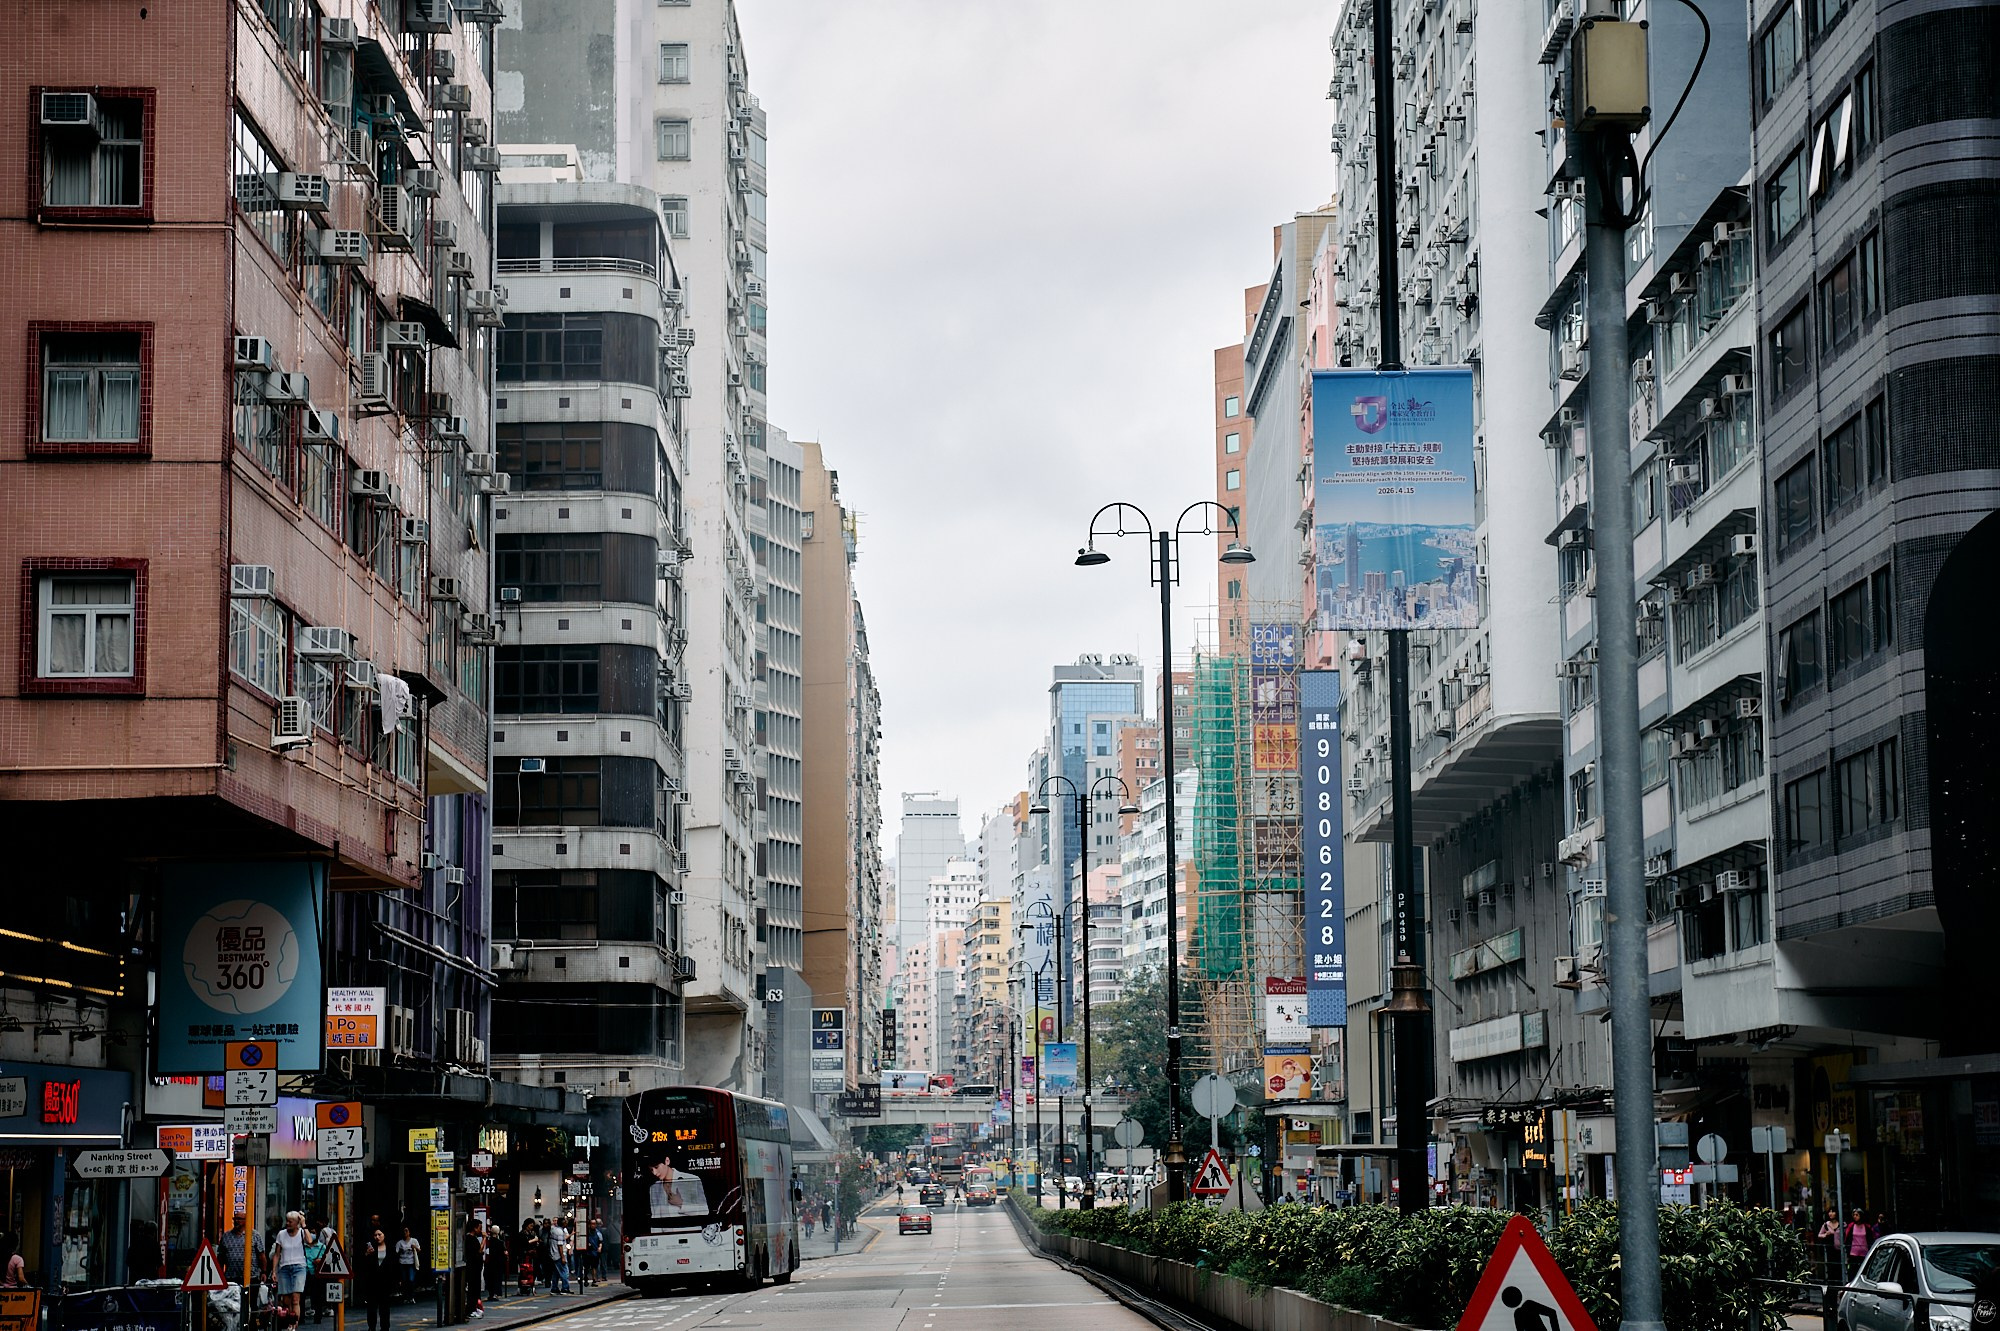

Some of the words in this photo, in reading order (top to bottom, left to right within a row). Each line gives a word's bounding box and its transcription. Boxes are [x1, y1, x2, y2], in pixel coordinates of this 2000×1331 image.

[1352, 455, 1434, 466] 堅持統籌發展和安全
[1378, 487, 1415, 495] 2026.4.15
[1254, 627, 1278, 643] bali
[1255, 643, 1278, 658] bar
[216, 926, 266, 952] 優品
[217, 953, 265, 963] BESTMART
[766, 988, 783, 1002] 63
[241, 1023, 299, 1036] 一站式體驗
[338, 1018, 356, 1031] Po
[327, 1033, 369, 1044] 城百貨
[259, 1072, 267, 1083] 7
[259, 1090, 267, 1101] 7
[1485, 1109, 1535, 1124] 象牙世家
[347, 1130, 354, 1140] 7
[194, 1139, 226, 1151] 手信店
[347, 1146, 355, 1156] 7
[91, 1153, 124, 1162] Nanking
[126, 1152, 152, 1161] Street
[104, 1164, 139, 1175] 南京街
[482, 1178, 496, 1186] YT
[481, 1185, 496, 1193] 122
